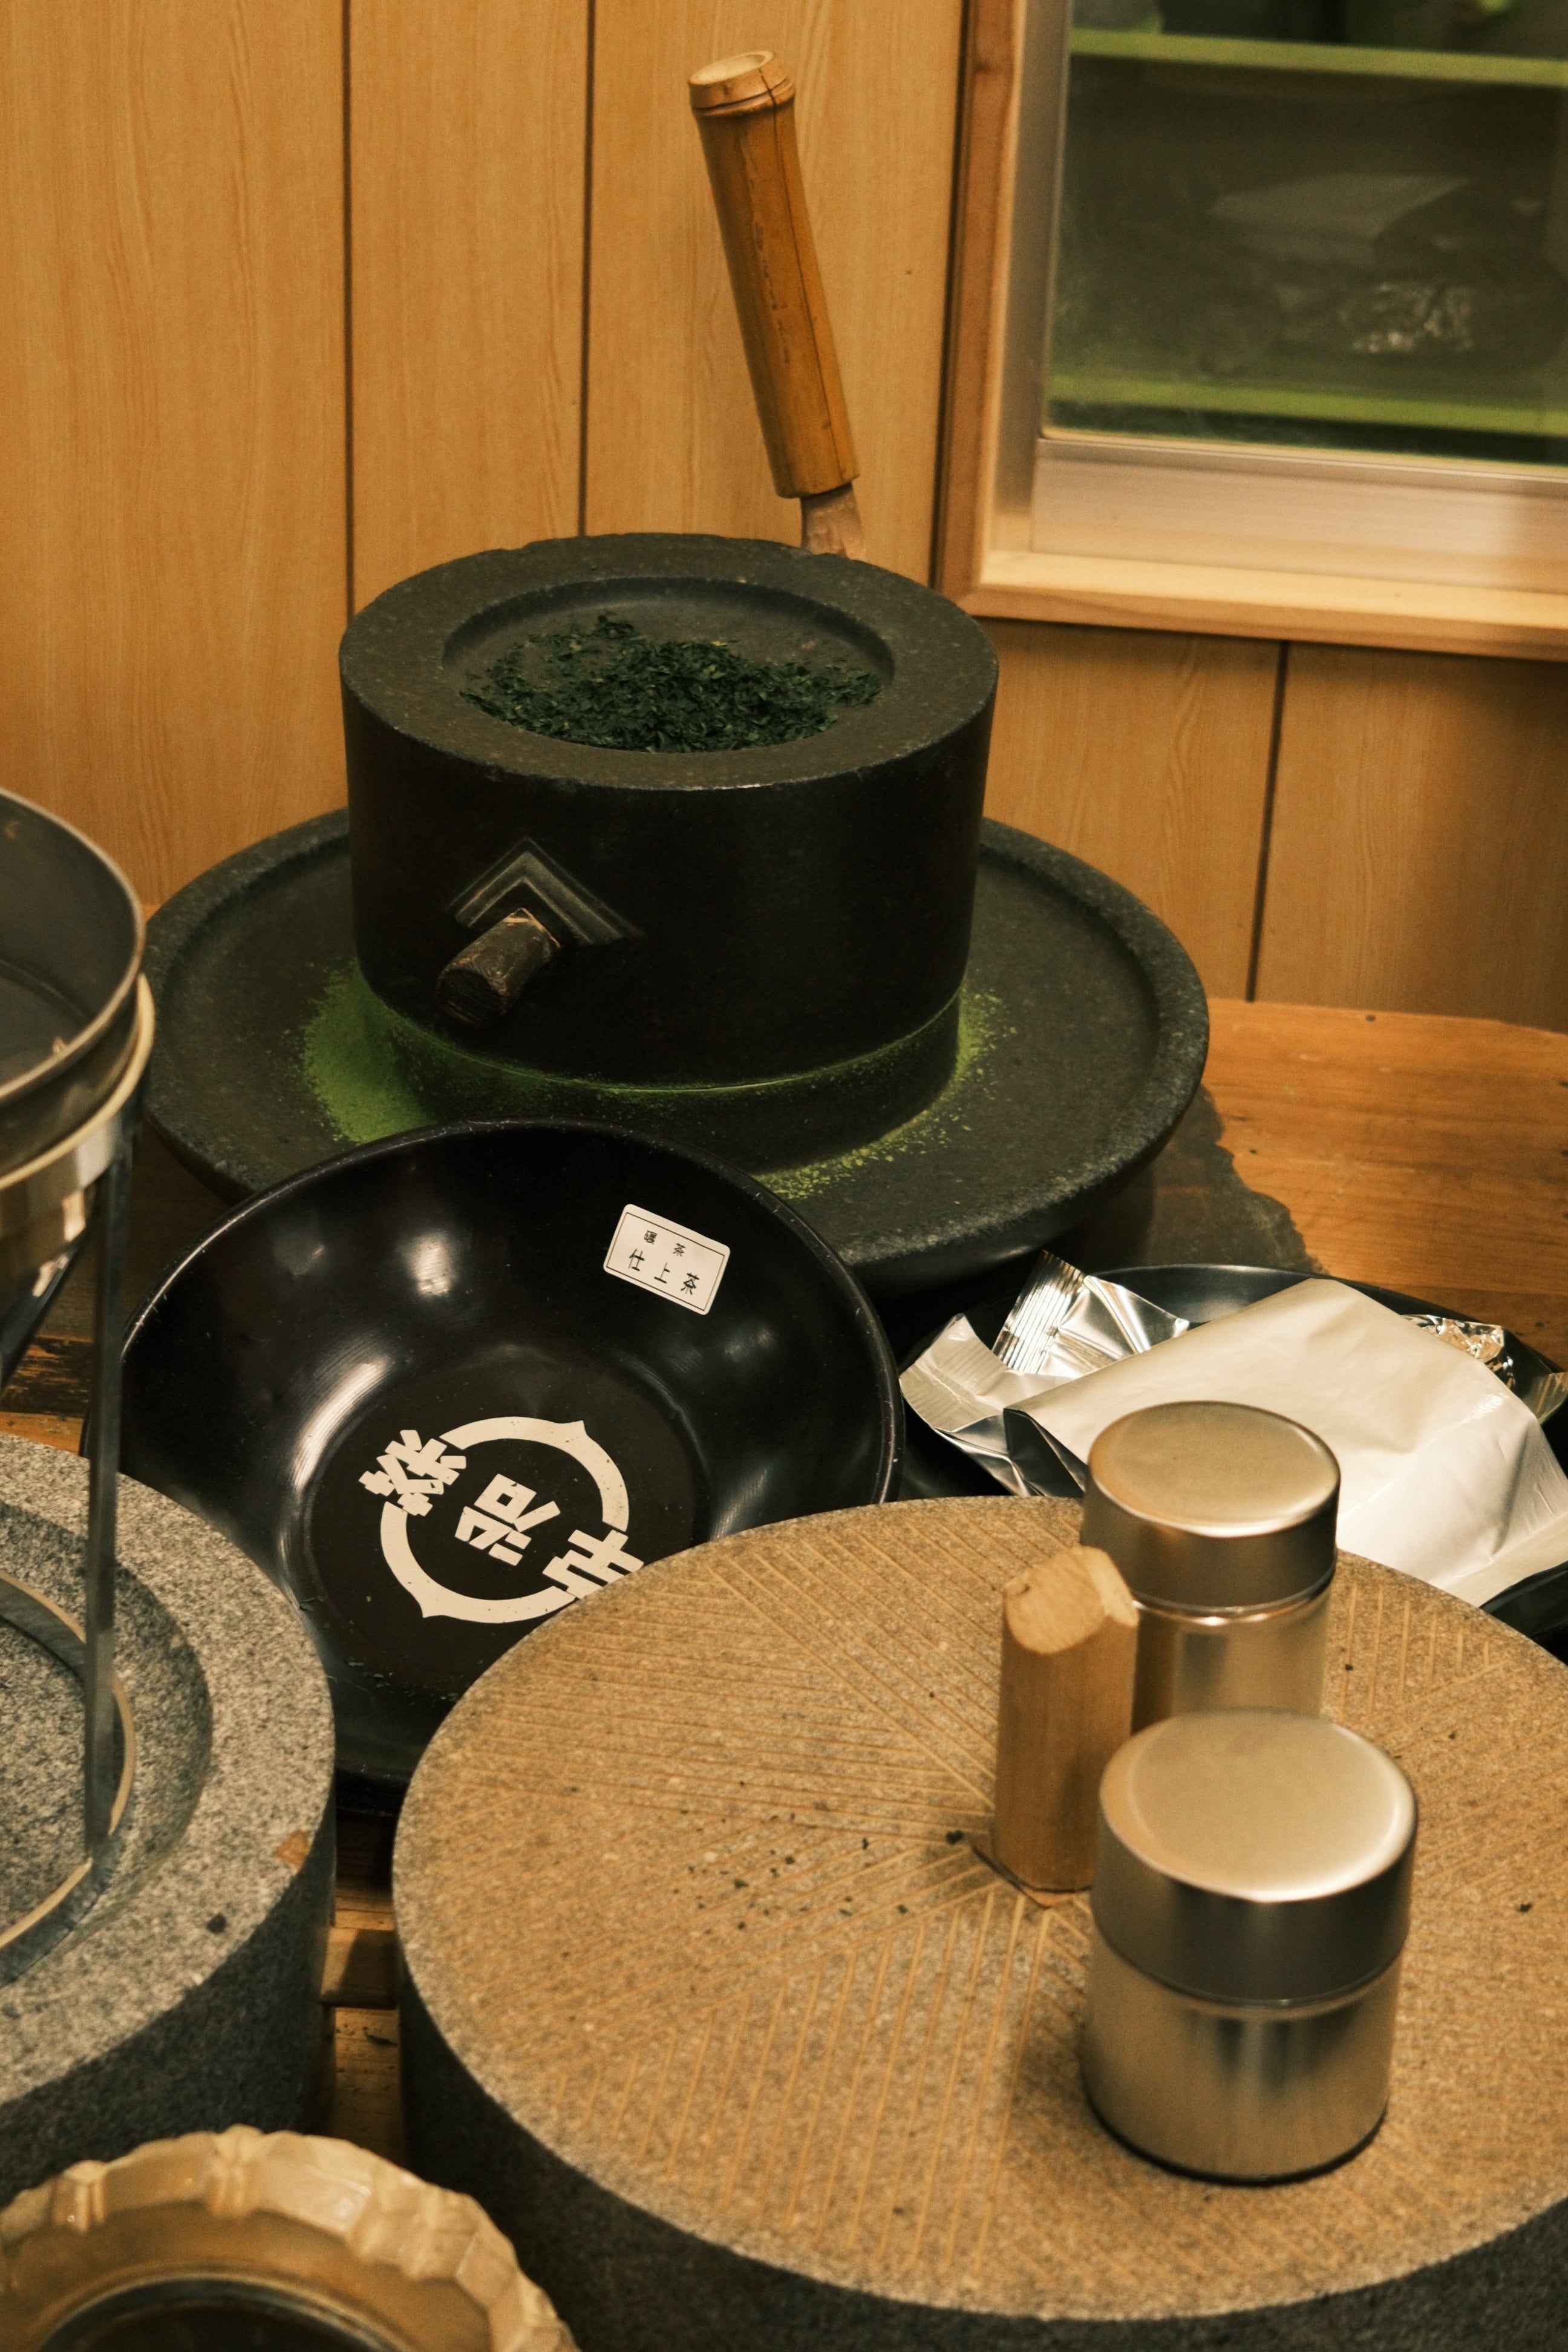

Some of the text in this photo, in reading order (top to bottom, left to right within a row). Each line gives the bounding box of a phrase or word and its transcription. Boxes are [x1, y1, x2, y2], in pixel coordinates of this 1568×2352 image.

[628, 1249, 700, 1295] 仕上茶
[359, 1429, 644, 1599] 宇治茶
